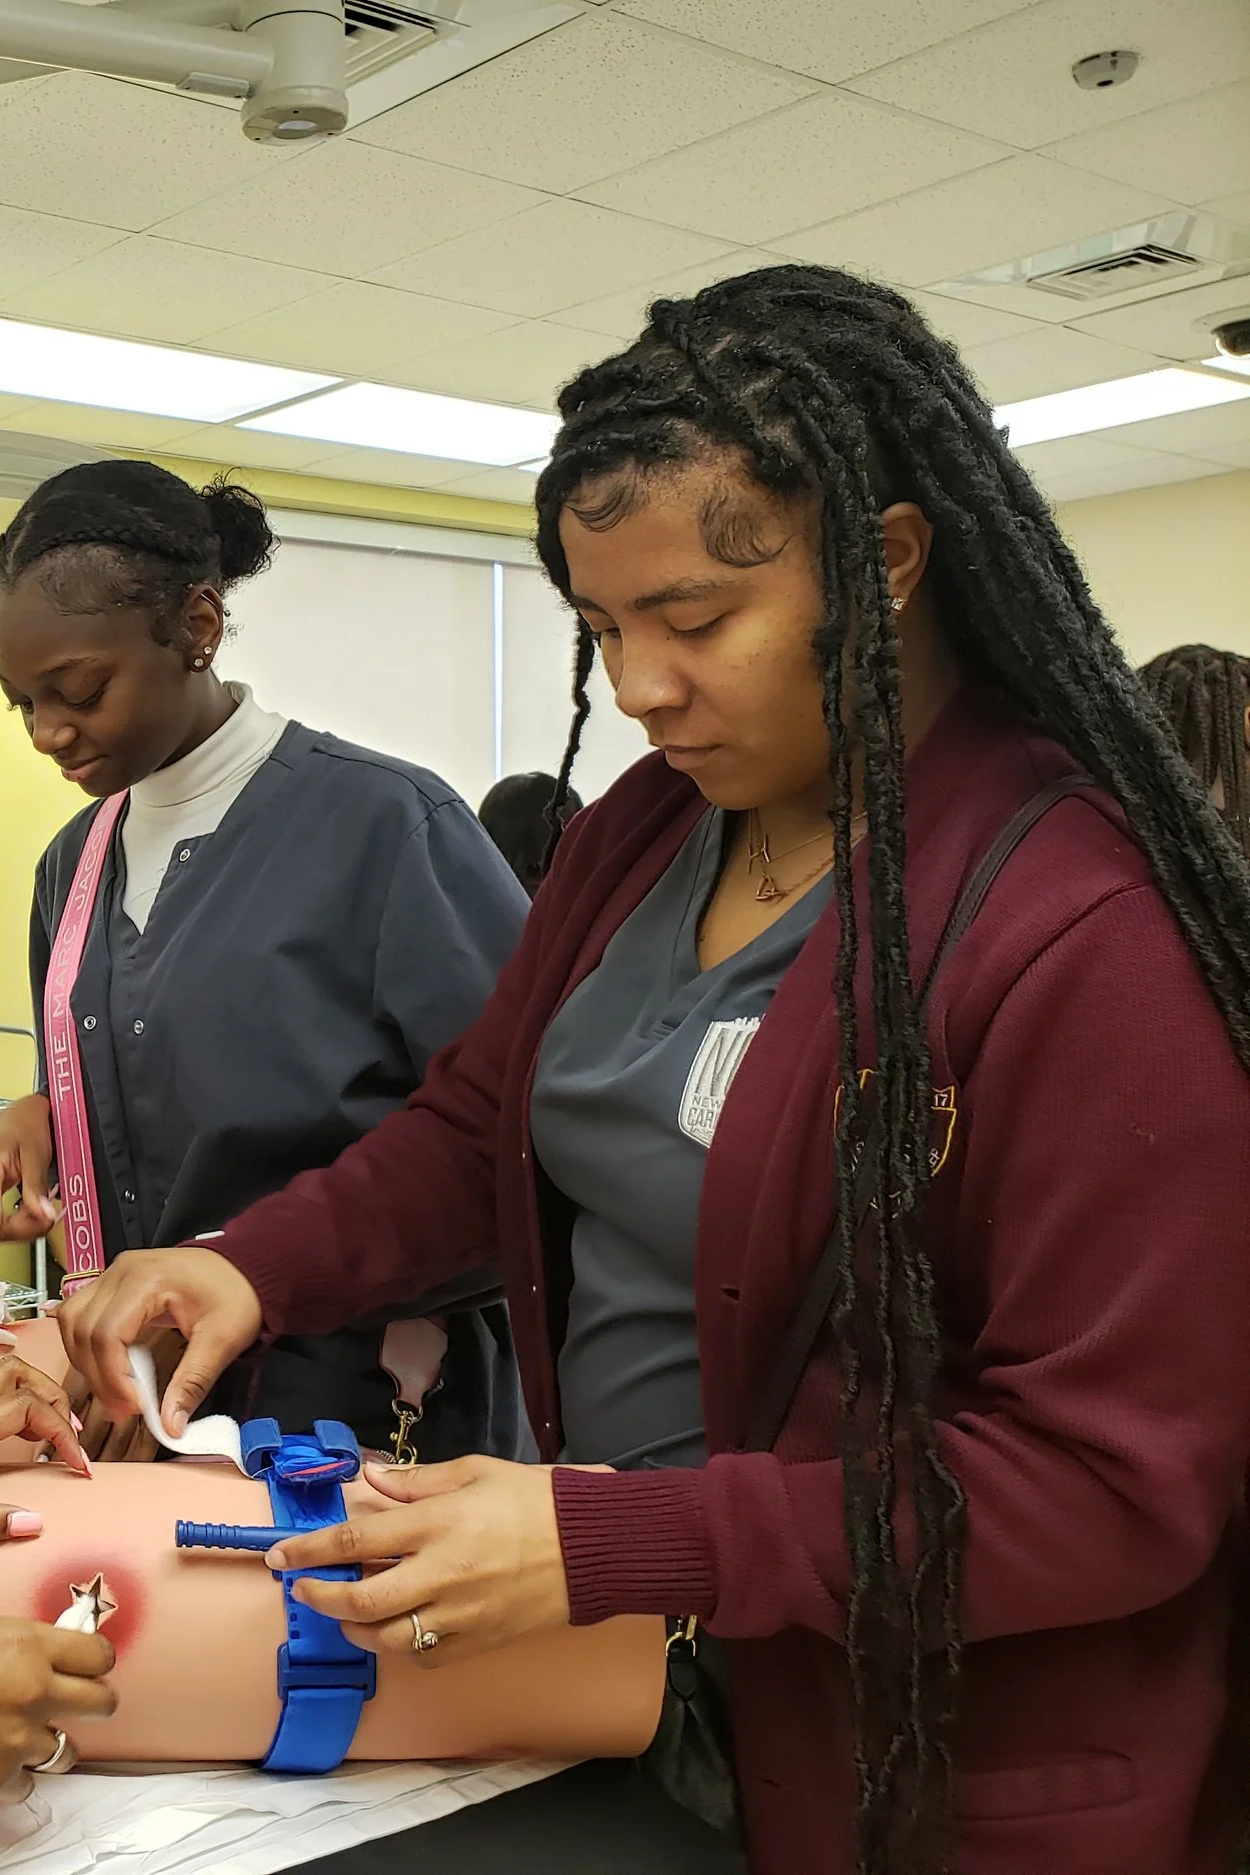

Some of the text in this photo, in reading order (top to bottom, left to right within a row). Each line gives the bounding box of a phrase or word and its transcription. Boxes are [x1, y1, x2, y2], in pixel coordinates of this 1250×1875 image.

[52, 817, 109, 1101] THE MARC JACO
[687, 1107, 715, 1128] CAR
[69, 1173, 93, 1272] COBS
